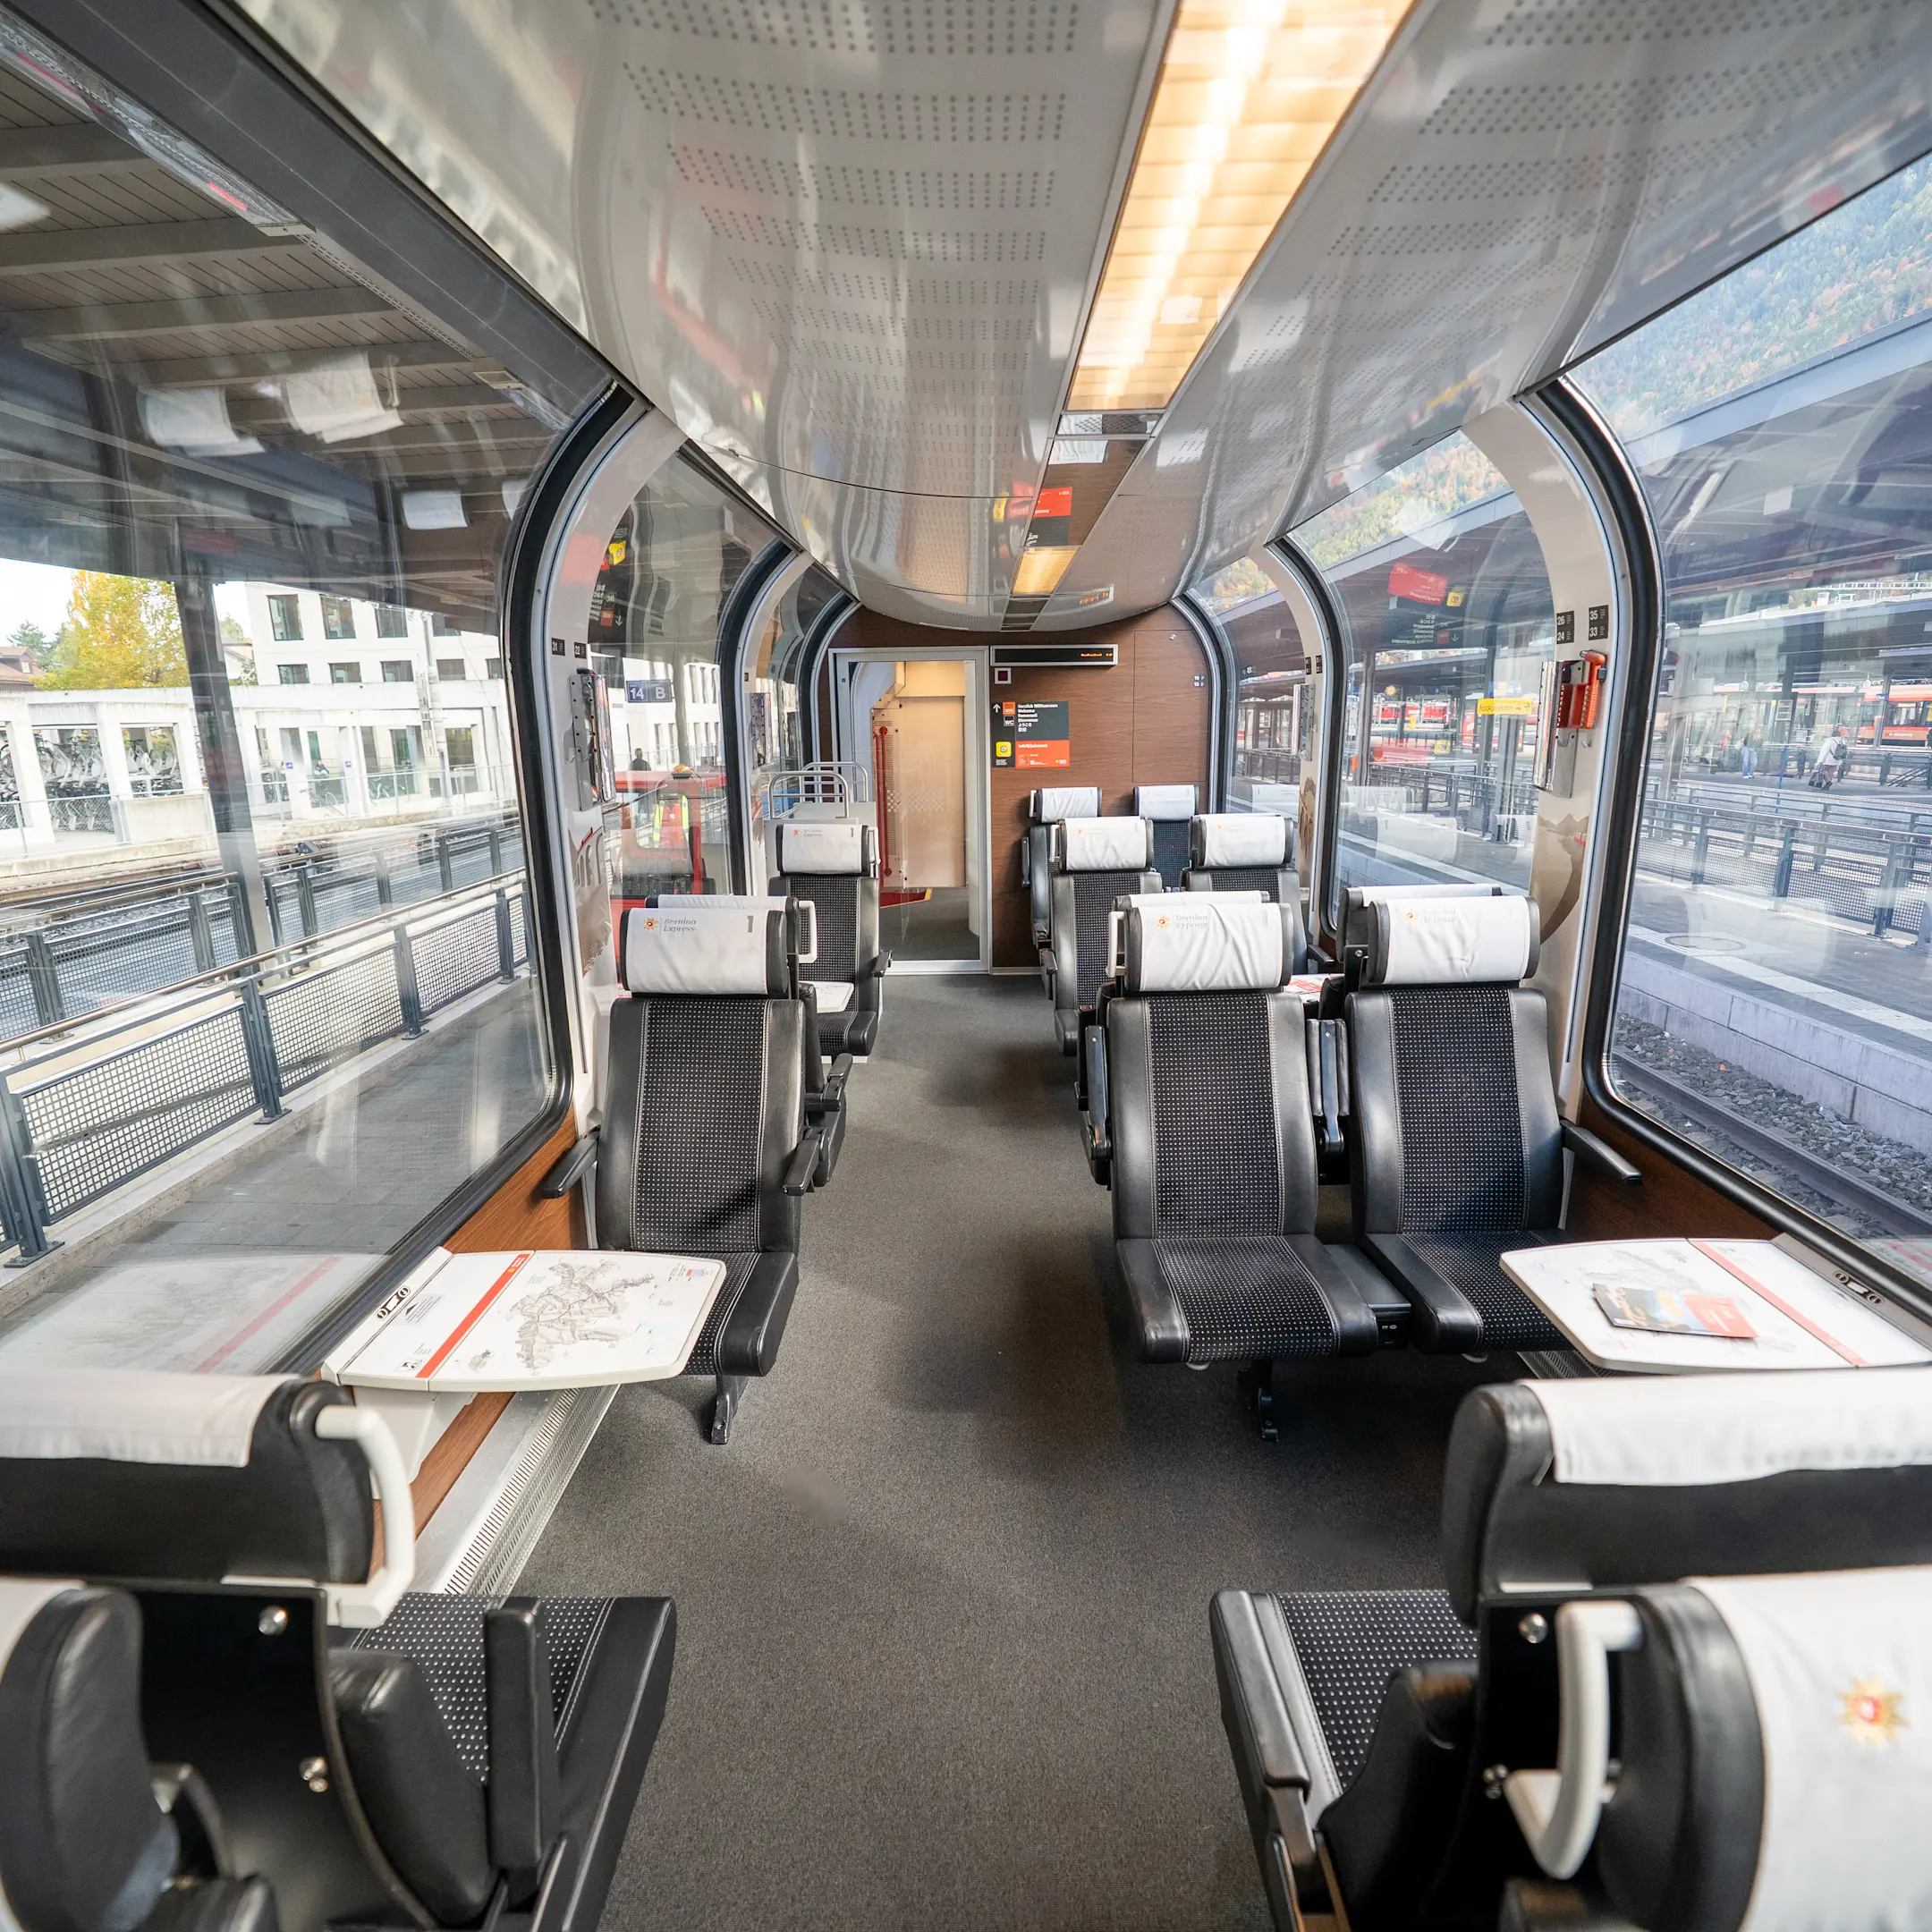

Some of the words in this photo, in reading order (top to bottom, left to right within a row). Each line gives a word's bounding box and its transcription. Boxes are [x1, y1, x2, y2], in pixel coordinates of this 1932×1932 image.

[1589, 610, 1598, 620] 35
[1557, 615, 1565, 626] 26
[1557, 631, 1564, 641] 24
[1589, 627, 1598, 637] 33
[574, 646, 580, 655] 22
[630, 688, 644, 699] 14
[656, 687, 665, 699] B
[663, 925, 696, 933] Express
[747, 915, 754, 933] 1
